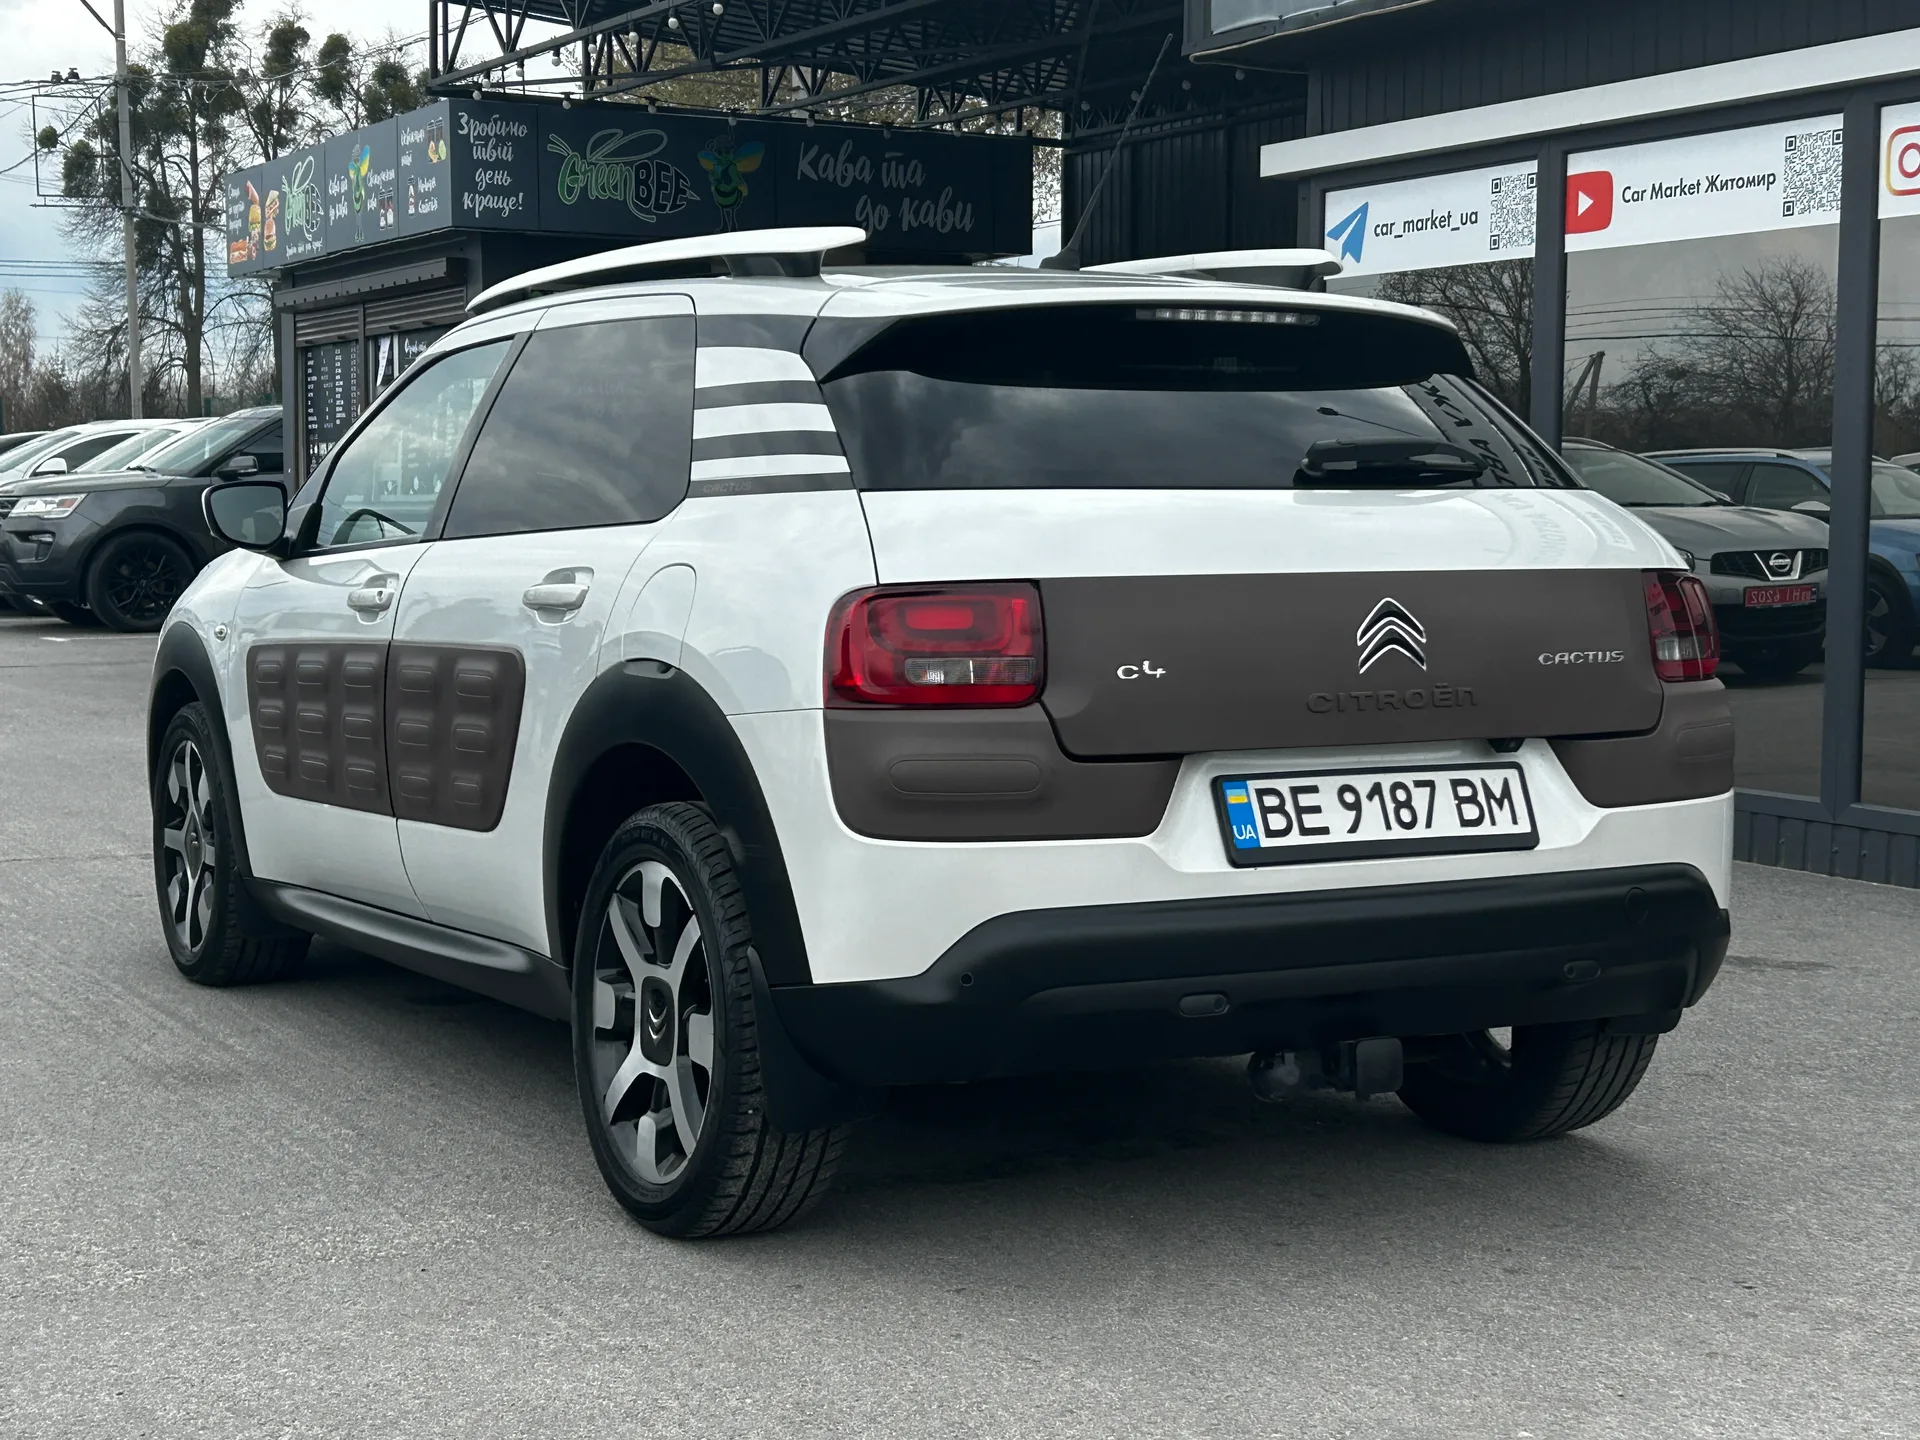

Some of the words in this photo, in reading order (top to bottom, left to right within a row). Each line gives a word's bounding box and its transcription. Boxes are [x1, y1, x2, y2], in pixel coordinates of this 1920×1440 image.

[458, 112, 528, 143] Зробимо
[473, 137, 514, 161] твій
[797, 140, 875, 187] Кава
[881, 152, 926, 189] та
[475, 168, 512, 191] день
[1622, 186, 1646, 203] Car
[1650, 178, 1701, 200] Market
[1704, 172, 1776, 194] Житомир
[462, 192, 523, 218] краще!
[855, 195, 891, 239] до
[899, 186, 975, 233] кави
[1374, 209, 1478, 238] car_market_ua
[1117, 660, 1166, 679] C4
[1538, 650, 1624, 665] CACTUS
[1254, 785, 1330, 838] BE
[1337, 779, 1436, 834] 9187
[1449, 777, 1518, 828] BM
[1233, 824, 1257, 841] UA
